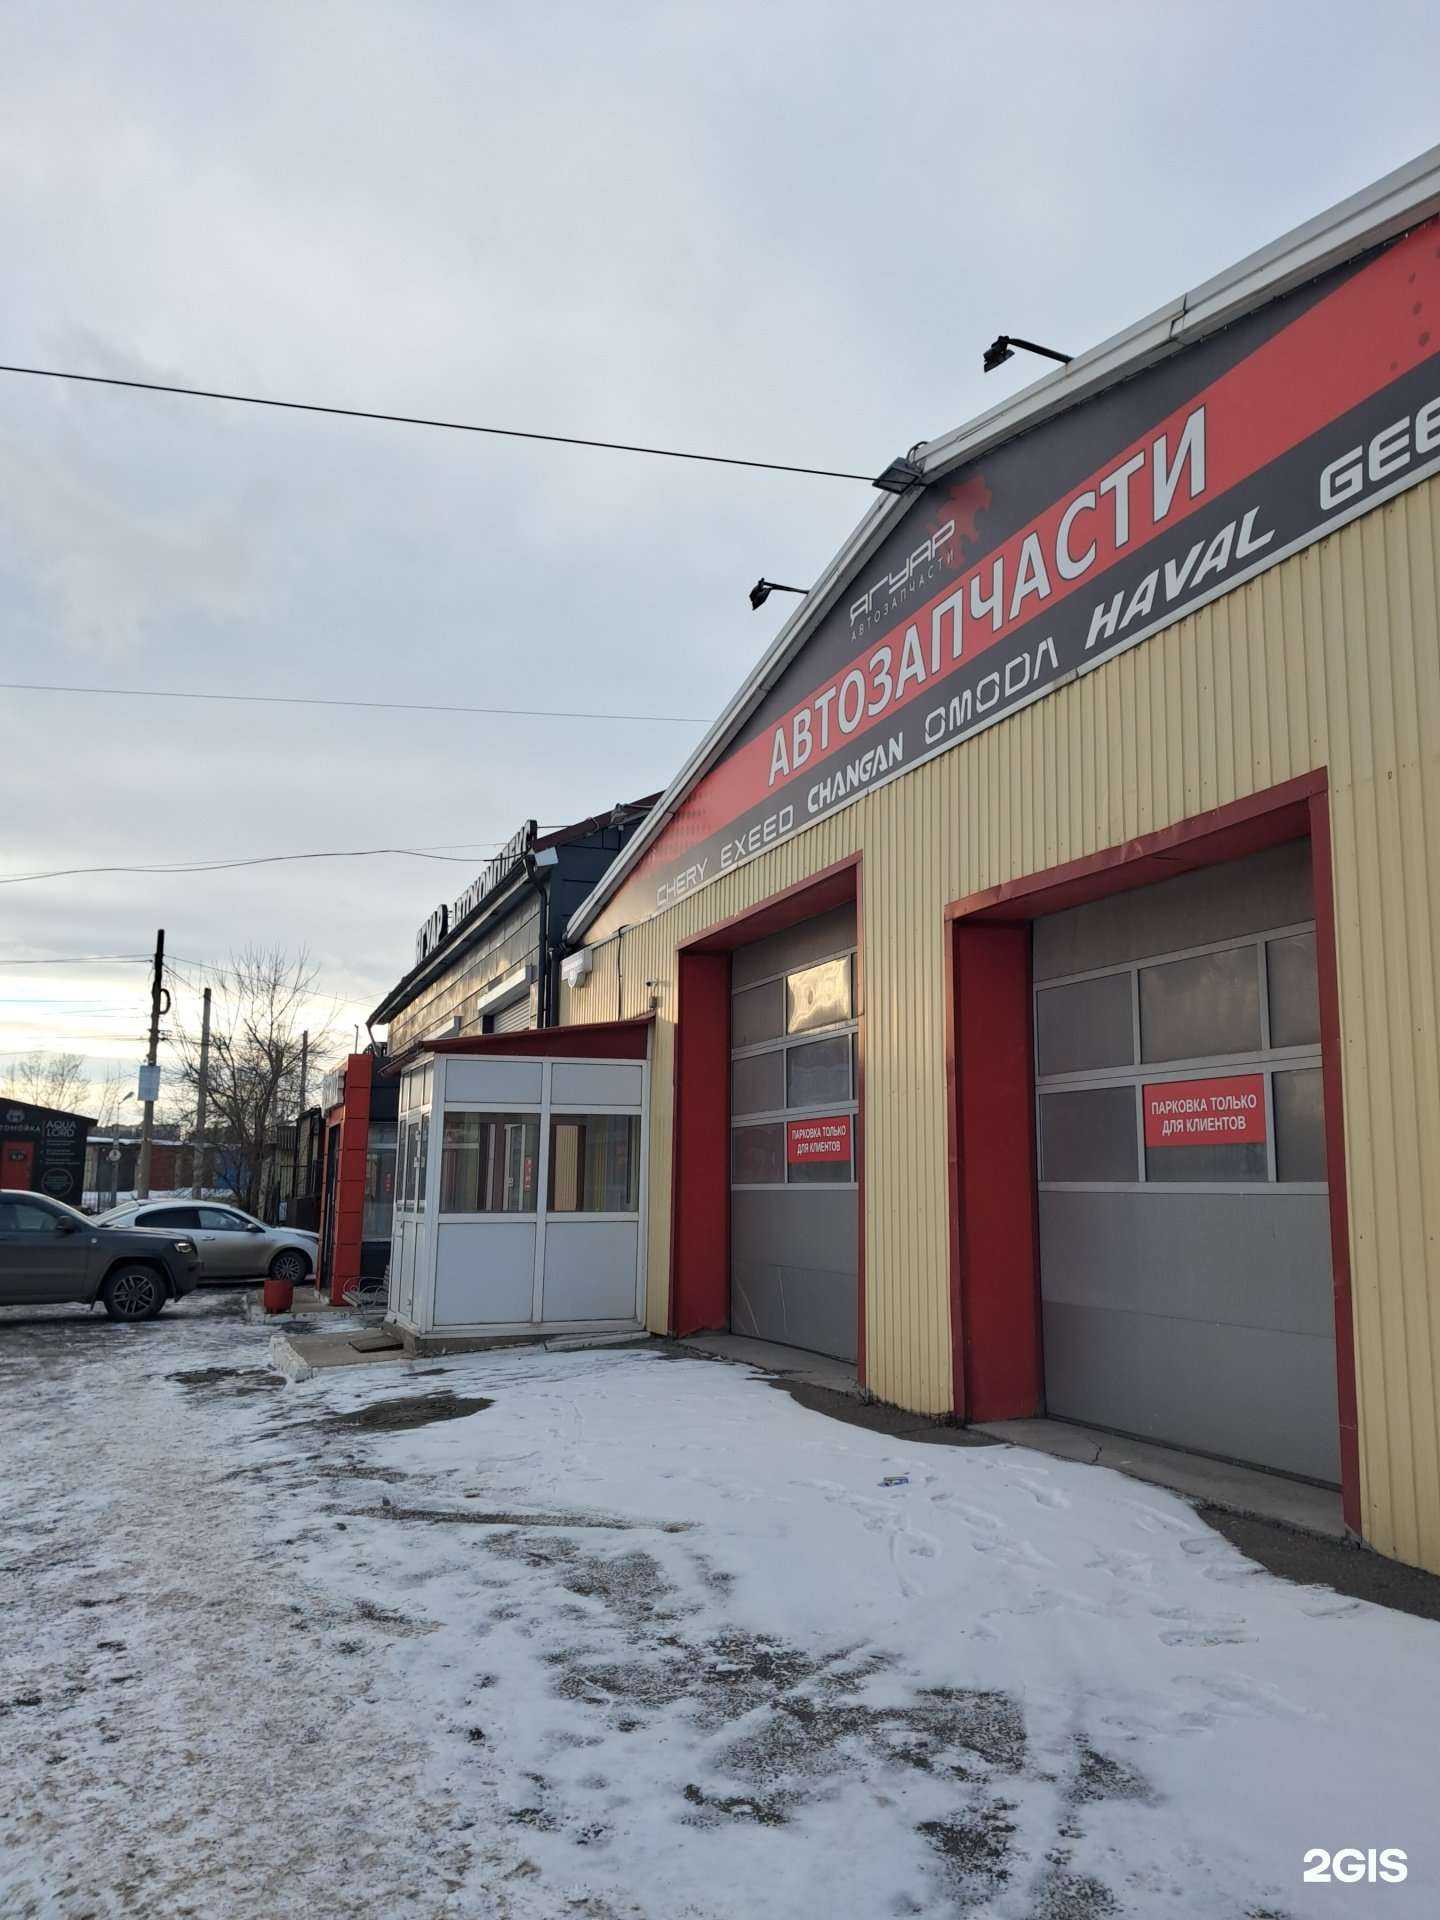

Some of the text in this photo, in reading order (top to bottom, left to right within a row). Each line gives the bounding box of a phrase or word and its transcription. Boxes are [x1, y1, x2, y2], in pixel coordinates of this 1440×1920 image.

[768, 404, 1207, 786] АВТОЗАПЧАСТИ
[851, 549, 954, 643] АВТОЗАПЧАСТИ
[656, 857, 708, 905] CHERY
[720, 804, 795, 869] EXEED
[806, 732, 905, 814] CHANGAN
[1085, 506, 1276, 650] HAVAL
[1320, 396, 1440, 511] GEE
[1151, 1094, 1257, 1115] ПАРКОВКА ТОЛЬКО
[46, 1120, 76, 1129] AQUA
[792, 1126, 846, 1140] ПАРКОВКА ТОЛЬКО
[1162, 1115, 1246, 1137] ДЛЯ КЛИЕНТОВ
[797, 1141, 841, 1156] ДЛЯ КЛИЕНТОВ
